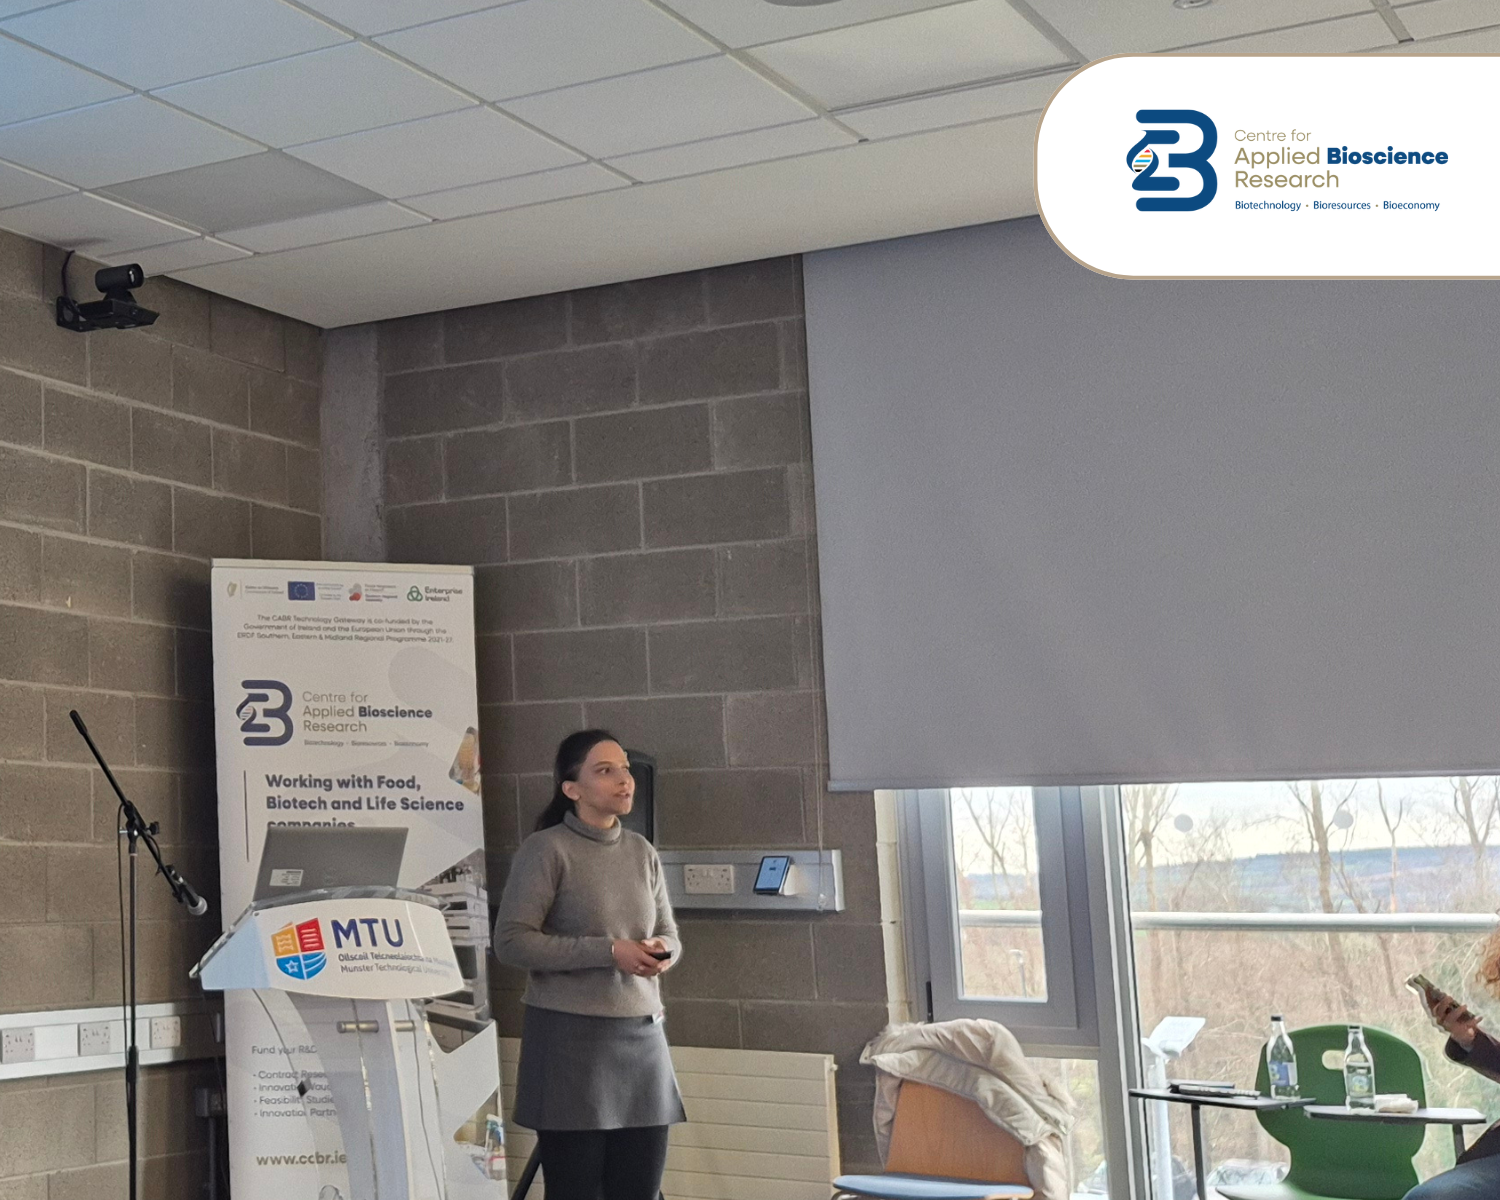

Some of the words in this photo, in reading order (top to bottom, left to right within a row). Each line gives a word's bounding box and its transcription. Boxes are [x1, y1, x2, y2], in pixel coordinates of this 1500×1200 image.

[424, 585, 463, 595] Enterprise
[271, 614, 292, 622] CABR
[293, 615, 332, 624] Technology
[333, 616, 366, 625] Gateway
[243, 623, 288, 631] Government
[351, 626, 384, 634] European
[406, 627, 434, 635] through
[354, 634, 385, 643] Regional
[386, 635, 427, 644] Programme
[302, 690, 346, 703] Centre
[350, 691, 368, 703] for
[302, 705, 355, 720] Applied
[358, 705, 433, 718] Bioscience
[303, 719, 367, 733] Research
[265, 773, 333, 792] Working
[336, 774, 373, 789] with
[376, 775, 421, 792] Food,
[266, 795, 328, 811] Biotech
[330, 796, 363, 811] and
[366, 796, 397, 811] Life
[400, 797, 464, 812] Science
[330, 918, 404, 949] MTU
[340, 963, 374, 974] Munster
[252, 1045, 276, 1054] Fund
[259, 1095, 301, 1105] Feasibilit
